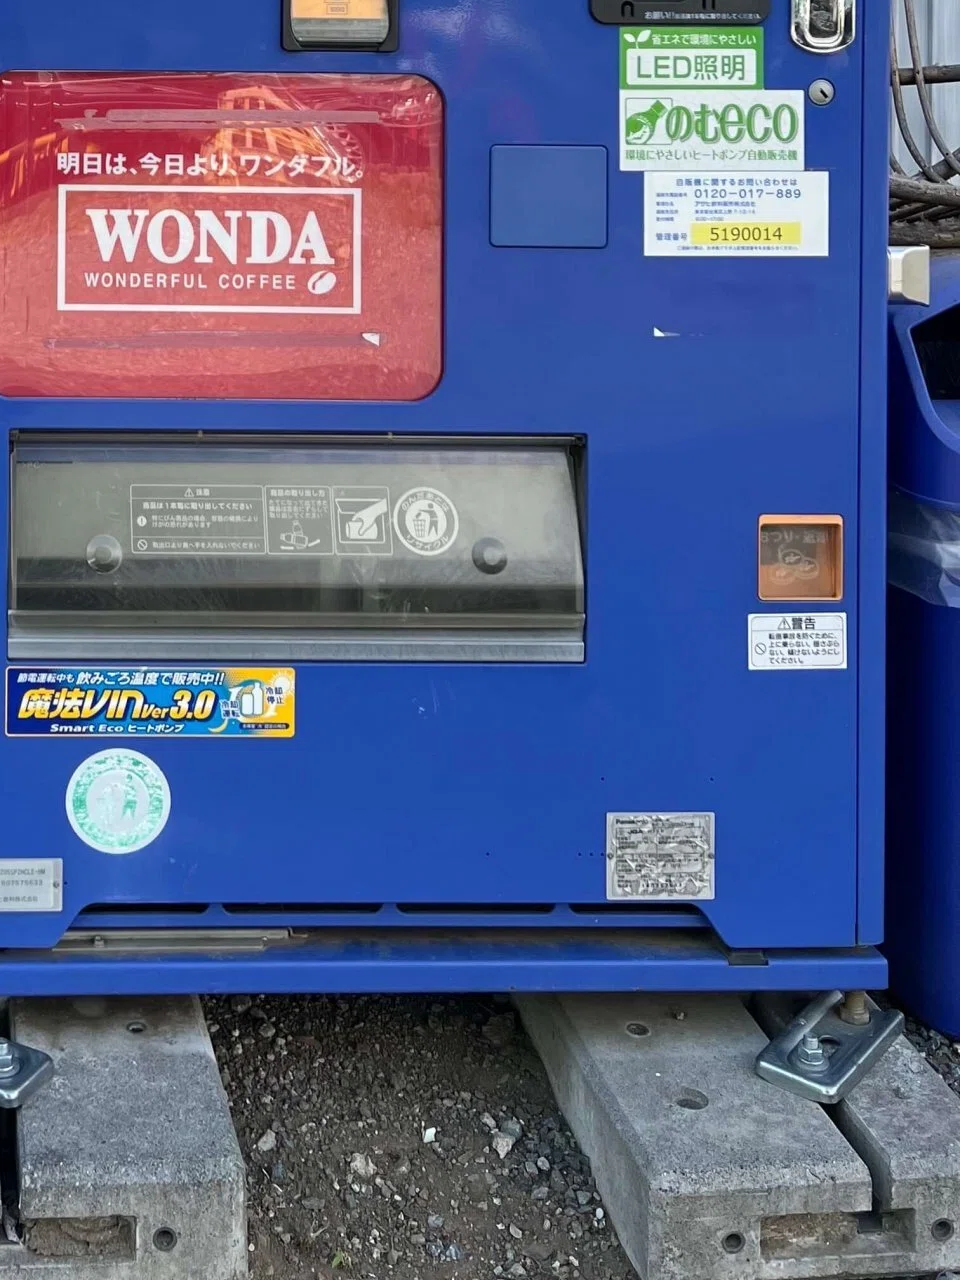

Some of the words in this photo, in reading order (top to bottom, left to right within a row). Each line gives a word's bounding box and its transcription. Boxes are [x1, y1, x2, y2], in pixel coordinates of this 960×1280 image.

[652, 33, 756, 46] 省エネで環境にやさしい
[637, 55, 746, 81] LED照明
[665, 104, 800, 145] のむeco
[625, 149, 798, 161] 環境にやさしいヒートポンプ自動販売機
[57, 152, 364, 184] 明日は、今日より、ワンダフル。
[676, 178, 798, 186] 自販機に関するお問い合わせは
[694, 189, 801, 199] 0120-017-889
[85, 209, 335, 265] WONDA
[656, 232, 688, 241] 管理番号
[710, 227, 783, 241] 5190014
[85, 272, 208, 290] WONDERFUL
[218, 274, 296, 290] COFFEE
[791, 618, 816, 630] 警告
[17, 672, 75, 683] 節電運転中も
[76, 671, 225, 686] 飲みごろ温度で販売中!!
[50, 724, 92, 733] Smart
[96, 724, 124, 733] Eco
[127, 724, 184, 733] ヒートポンプ
